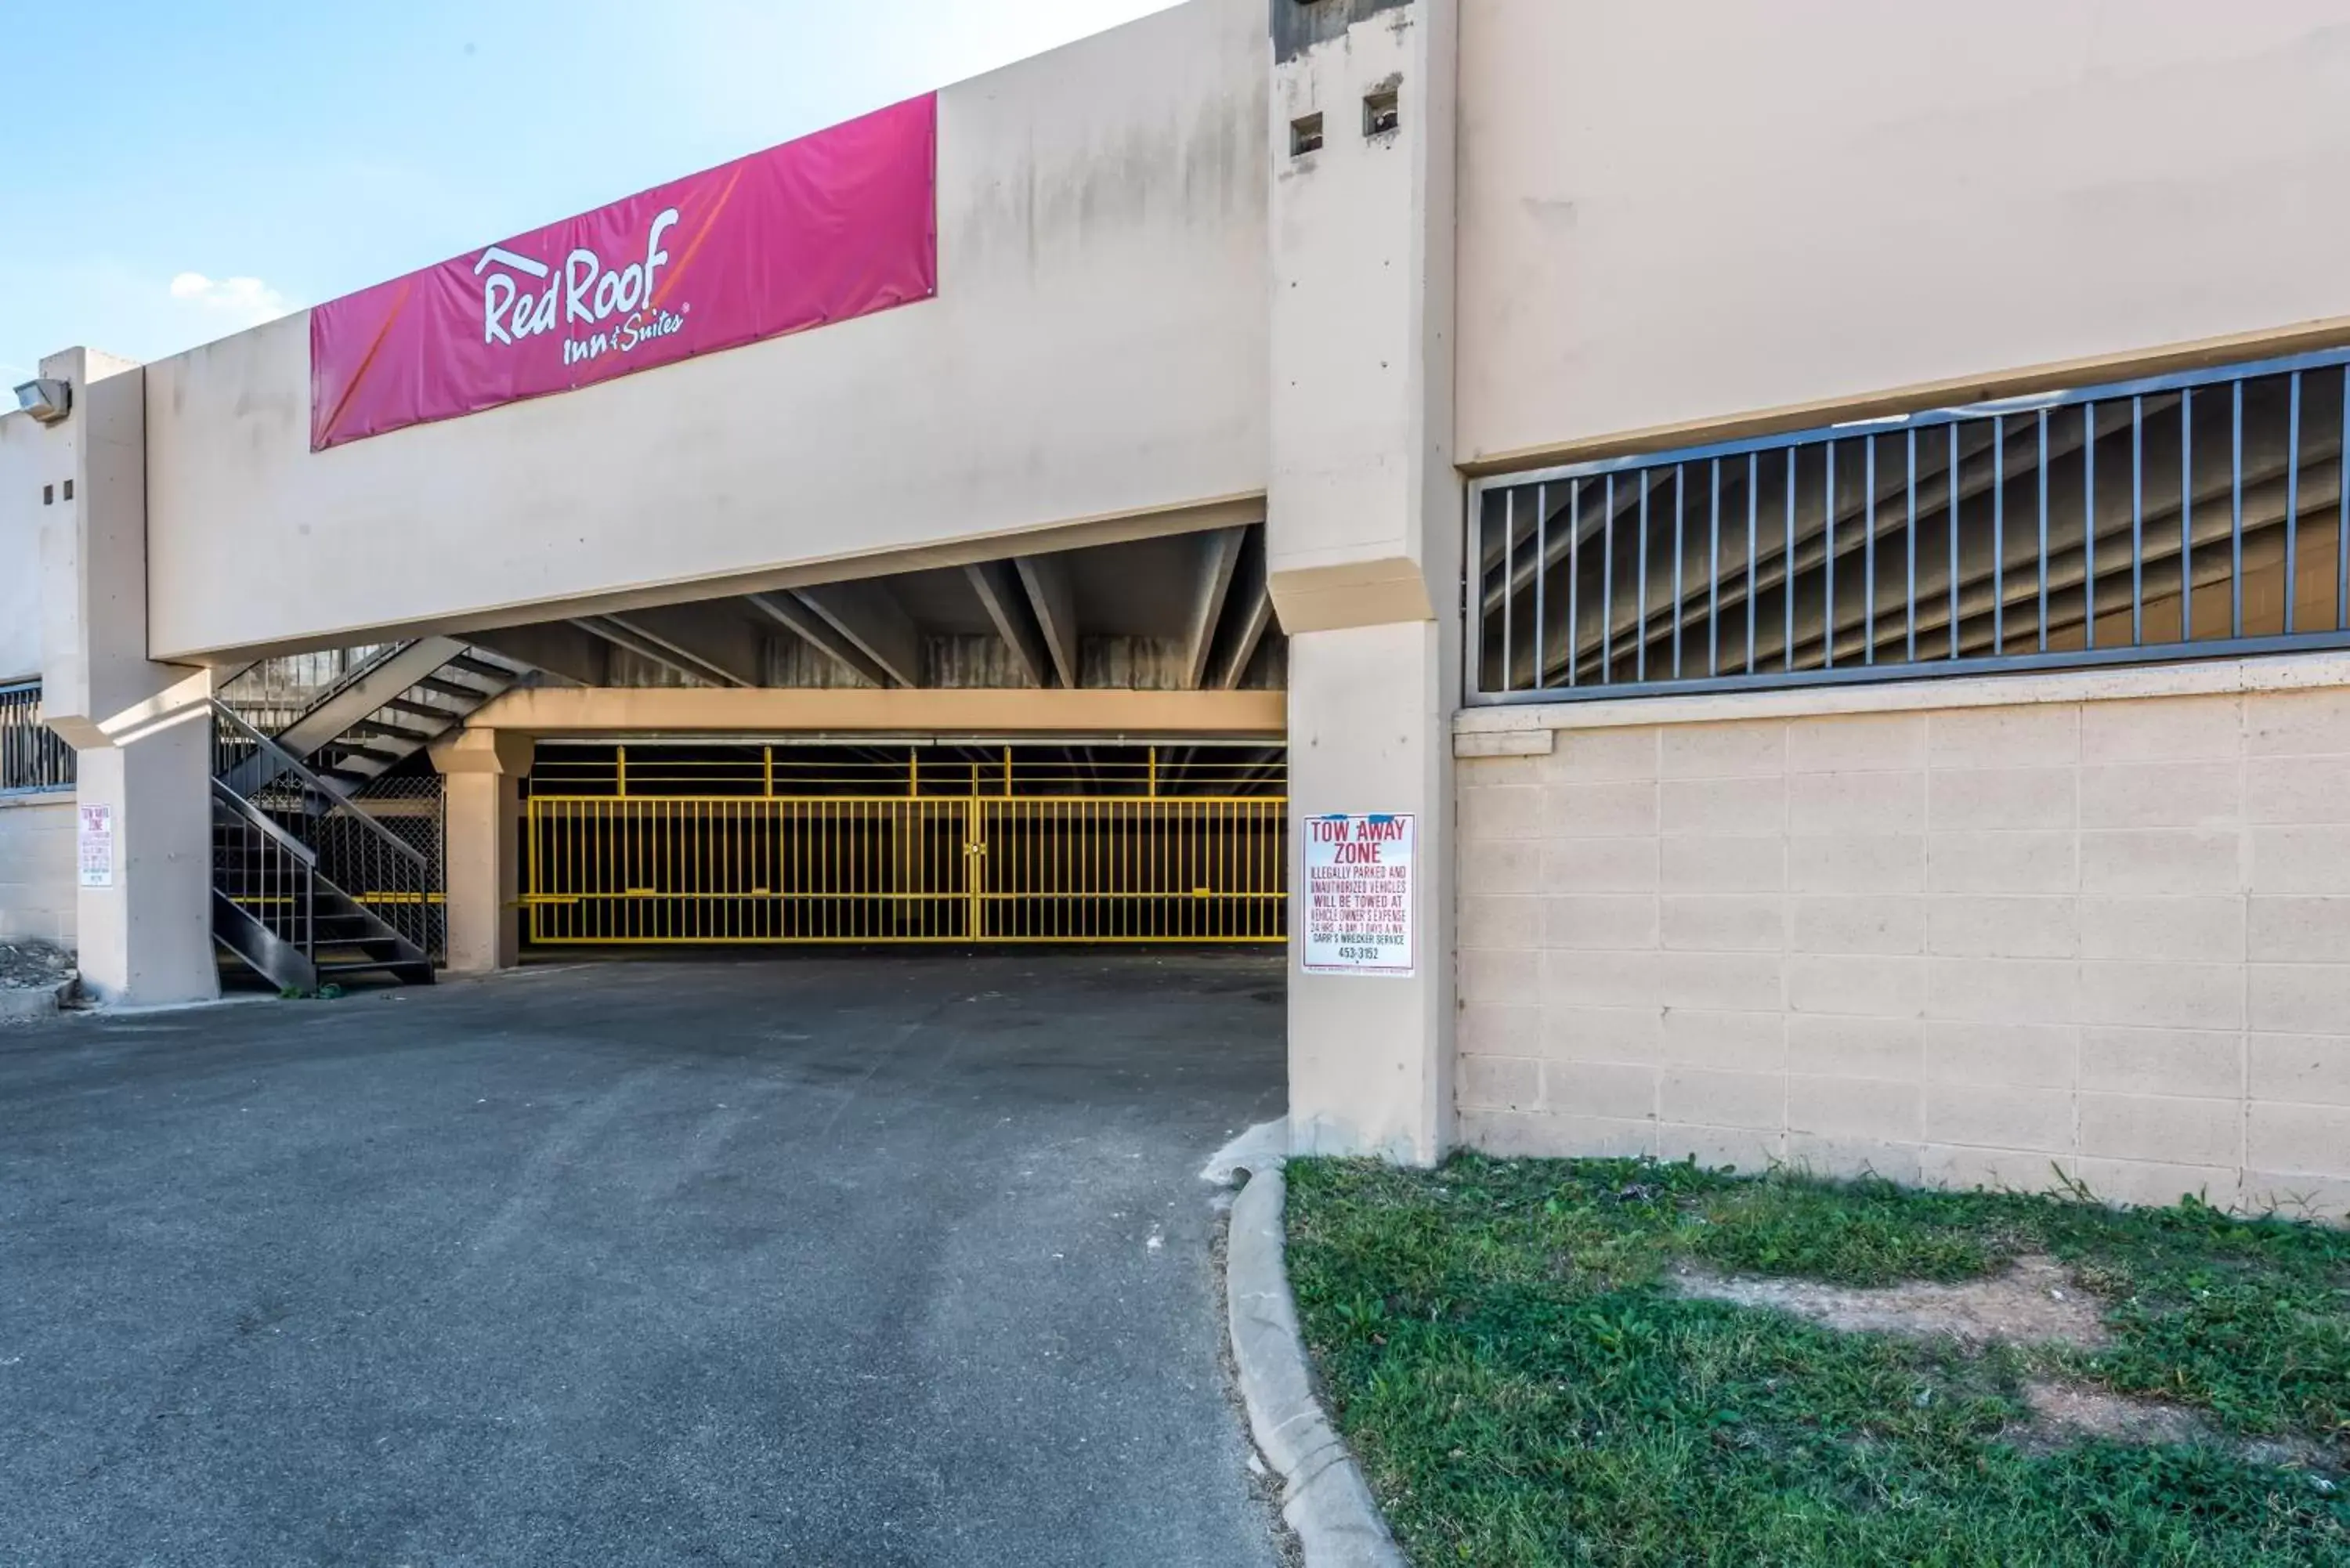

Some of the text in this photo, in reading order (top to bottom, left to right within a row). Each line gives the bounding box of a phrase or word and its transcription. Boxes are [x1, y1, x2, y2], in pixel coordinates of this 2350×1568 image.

[484, 208, 679, 345] Red Roof
[563, 333, 608, 365] Inn
[1311, 819, 1405, 842] TOW AWAY
[1334, 843, 1382, 864] ZONE
[1311, 866, 1406, 879] ILLEGALLY PARKED AND
[1311, 880, 1406, 894] UNAUTHORIZED VEHICLES
[1314, 895, 1402, 908] WILL BE TOWED AT
[1311, 909, 1337, 922] VEHICLE
[1373, 909, 1406, 923] EXPENSE
[1340, 933, 1375, 944] WRECKER
[1376, 934, 1405, 945] SERVICE
[1338, 947, 1379, 959] 453-3152
